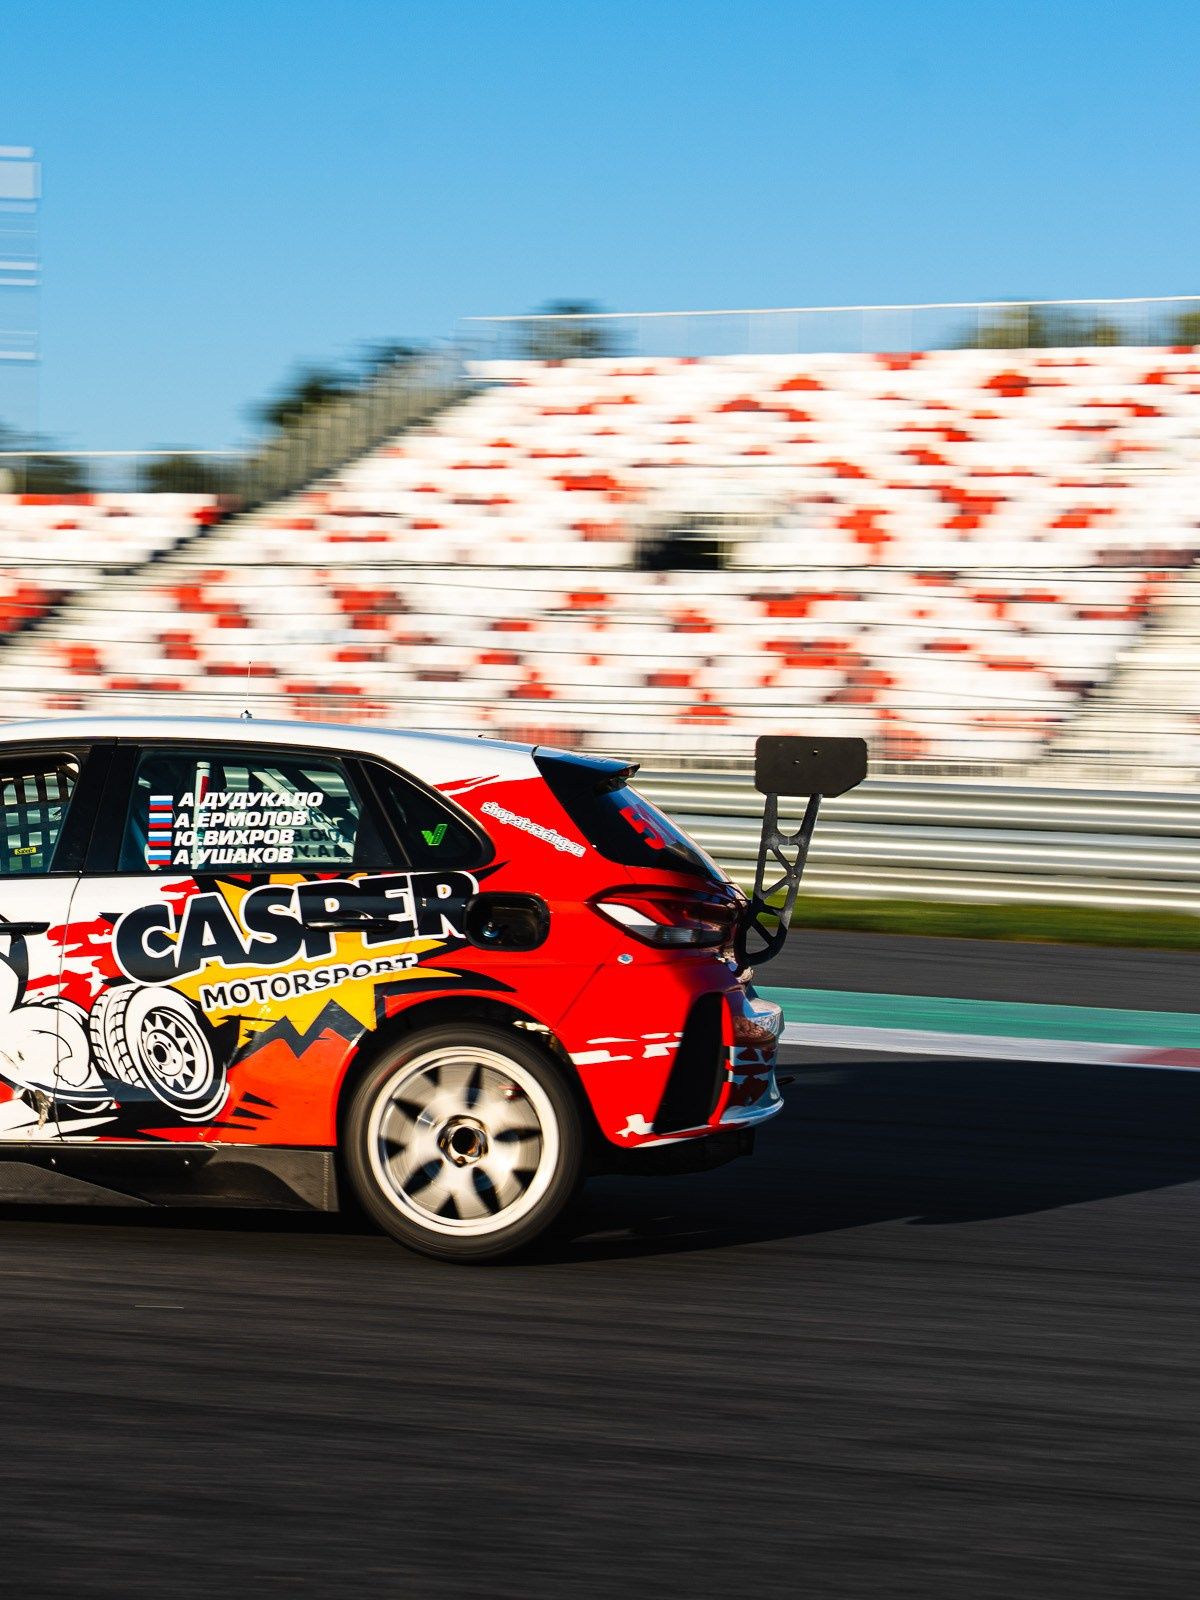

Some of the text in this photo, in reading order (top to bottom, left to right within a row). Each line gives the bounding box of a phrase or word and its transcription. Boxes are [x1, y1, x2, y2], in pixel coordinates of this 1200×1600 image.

[174, 812, 307, 828] А.ЕРМОЛОВ
[174, 830, 295, 846] Ю.ВИХРОВ
[173, 848, 294, 864] А.УШАКОВ
[112, 871, 480, 987] CASPER
[202, 956, 414, 1009] MOTORSPORT
